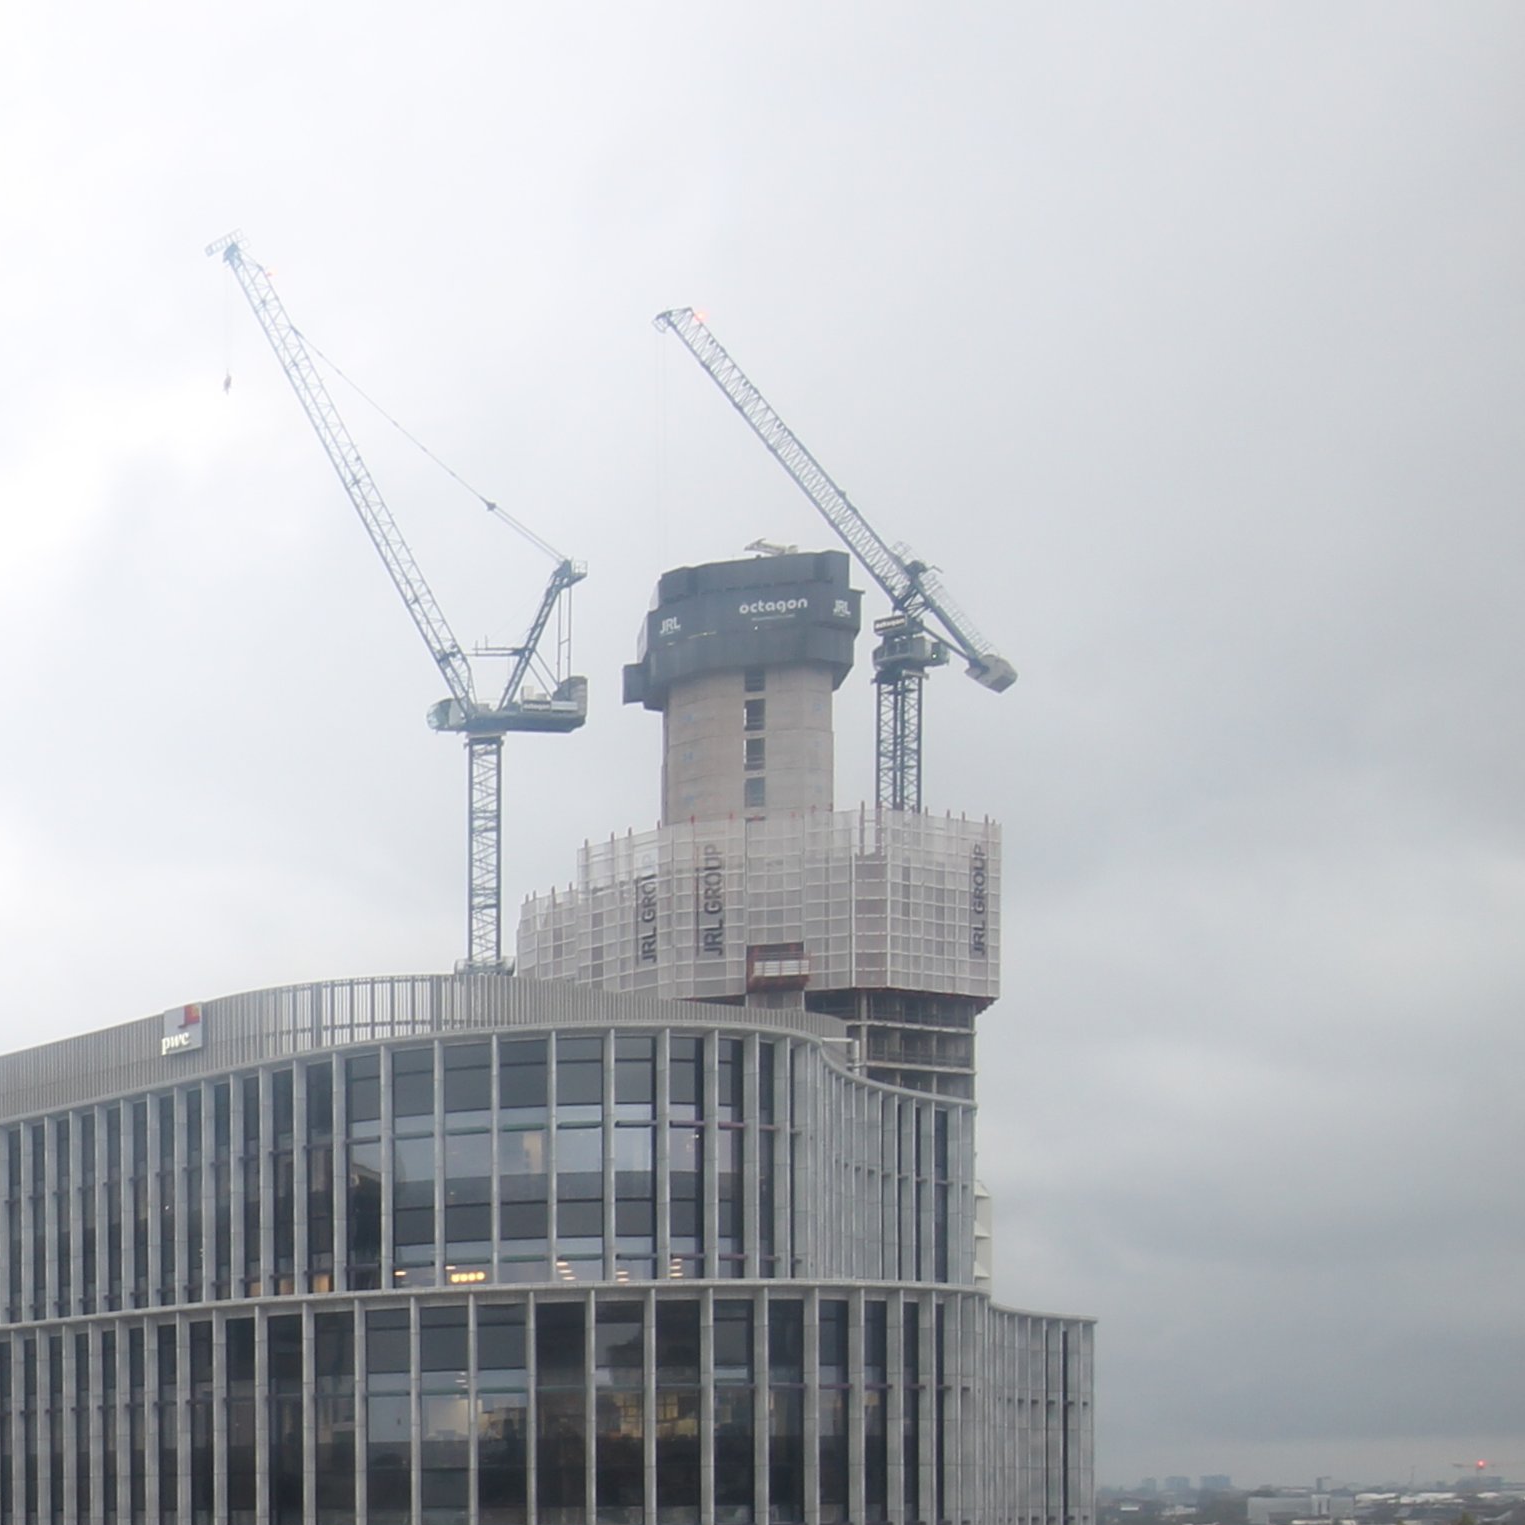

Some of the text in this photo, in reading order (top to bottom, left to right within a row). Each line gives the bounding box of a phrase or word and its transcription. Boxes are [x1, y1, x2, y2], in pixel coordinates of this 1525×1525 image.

[739, 597, 808, 615] octagon
[833, 599, 852, 616] JRL
[659, 616, 681, 635] JRL
[704, 844, 723, 956] JRL GROUP
[973, 843, 986, 956] JRL GROUP
[641, 927, 657, 963] JRL
[161, 1031, 190, 1056] pwc
